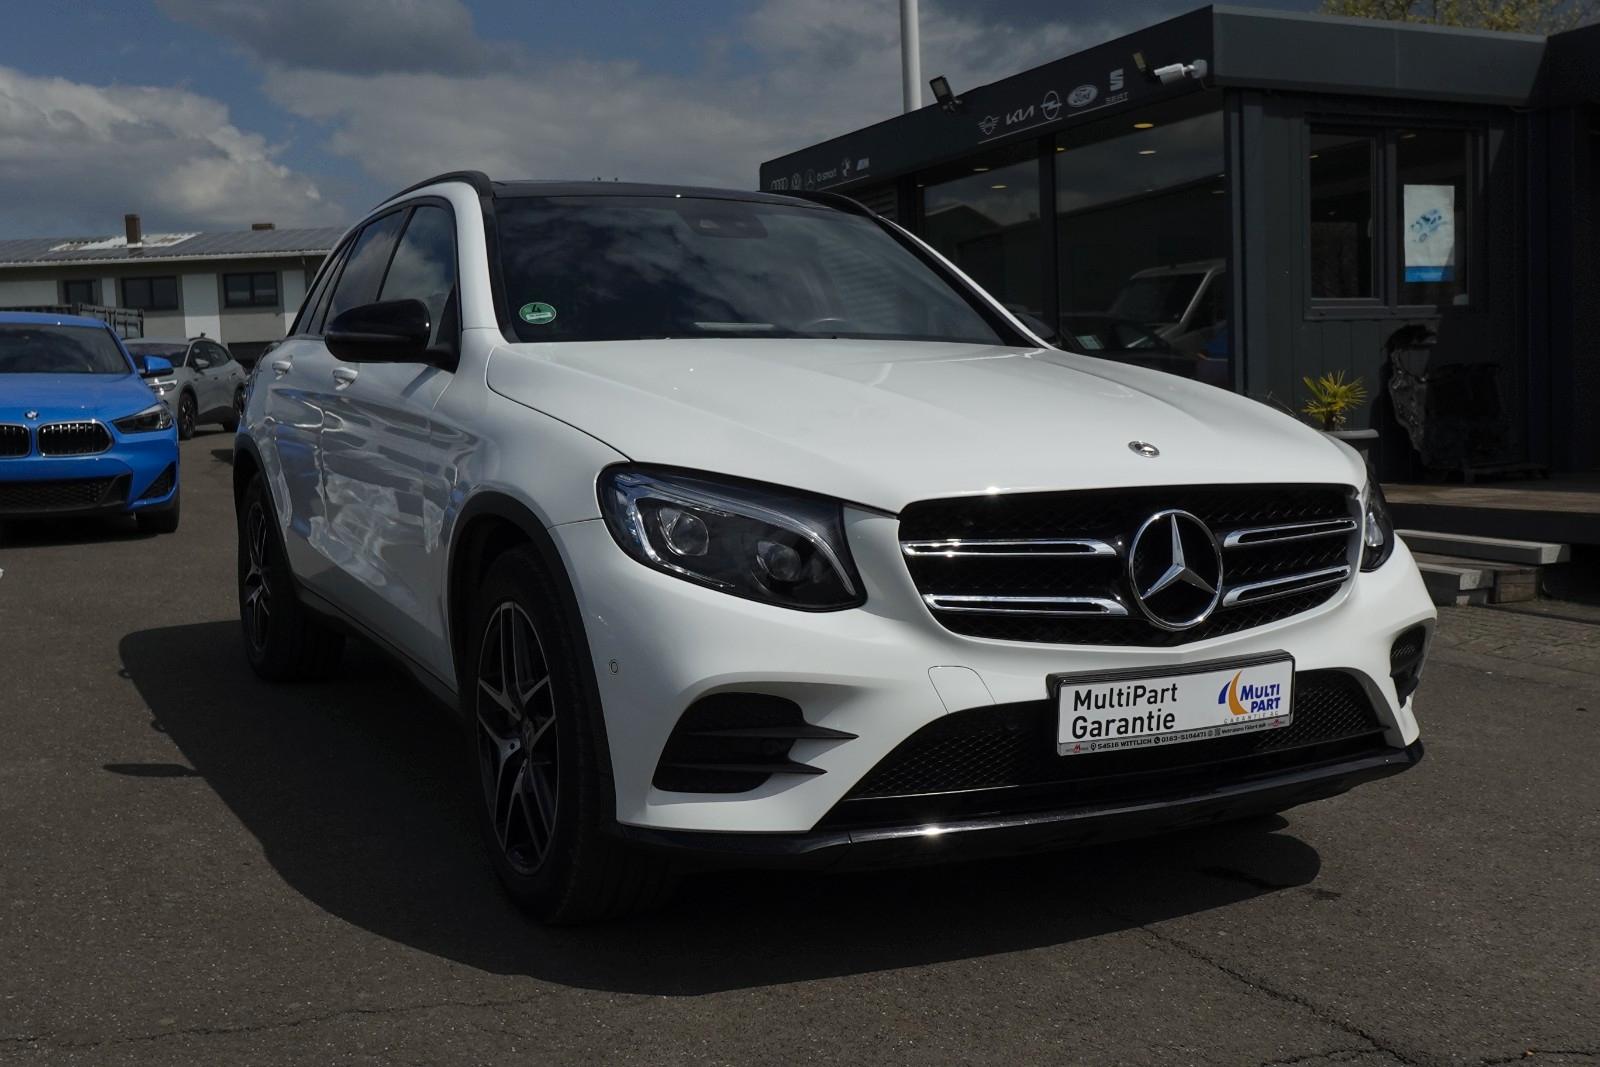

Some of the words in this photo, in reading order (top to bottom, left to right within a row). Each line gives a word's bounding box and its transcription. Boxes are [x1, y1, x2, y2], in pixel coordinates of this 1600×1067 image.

[1073, 683, 1178, 711] MultiPart
[1250, 696, 1281, 713] PART
[1072, 708, 1176, 739] Garantie
[1120, 739, 1152, 748] WITTLICH
